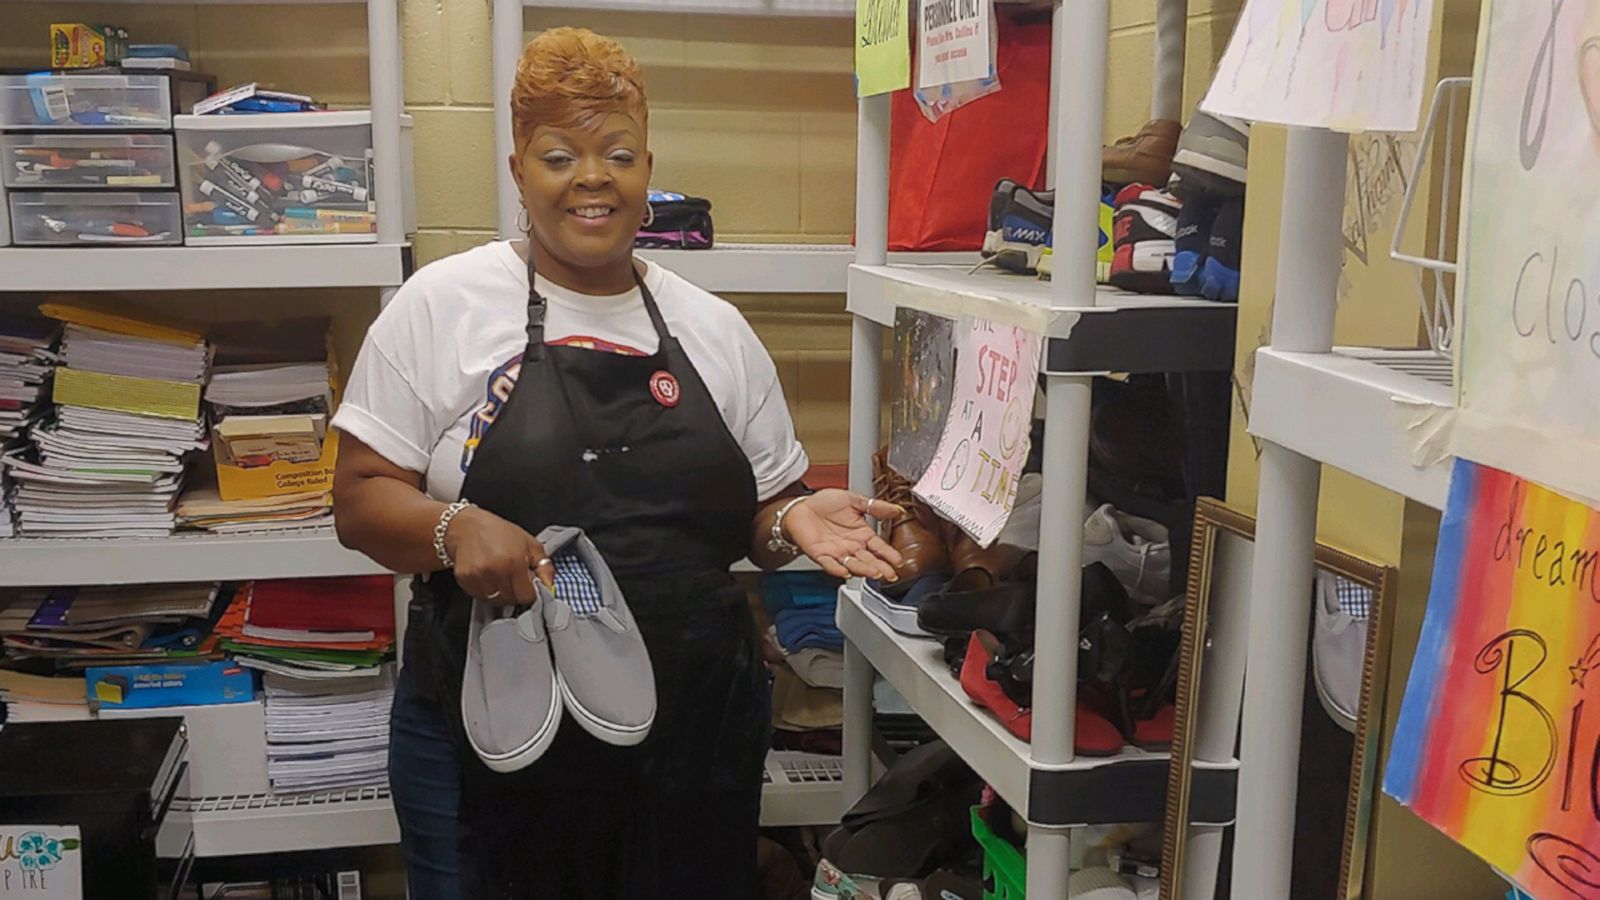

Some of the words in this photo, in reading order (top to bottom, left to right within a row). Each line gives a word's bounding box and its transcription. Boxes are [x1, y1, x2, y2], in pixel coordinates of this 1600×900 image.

[925, 0, 957, 32] PERSONNEL
[976, 345, 1017, 402] STEP
[961, 400, 974, 420] AT
[971, 410, 983, 443] A
